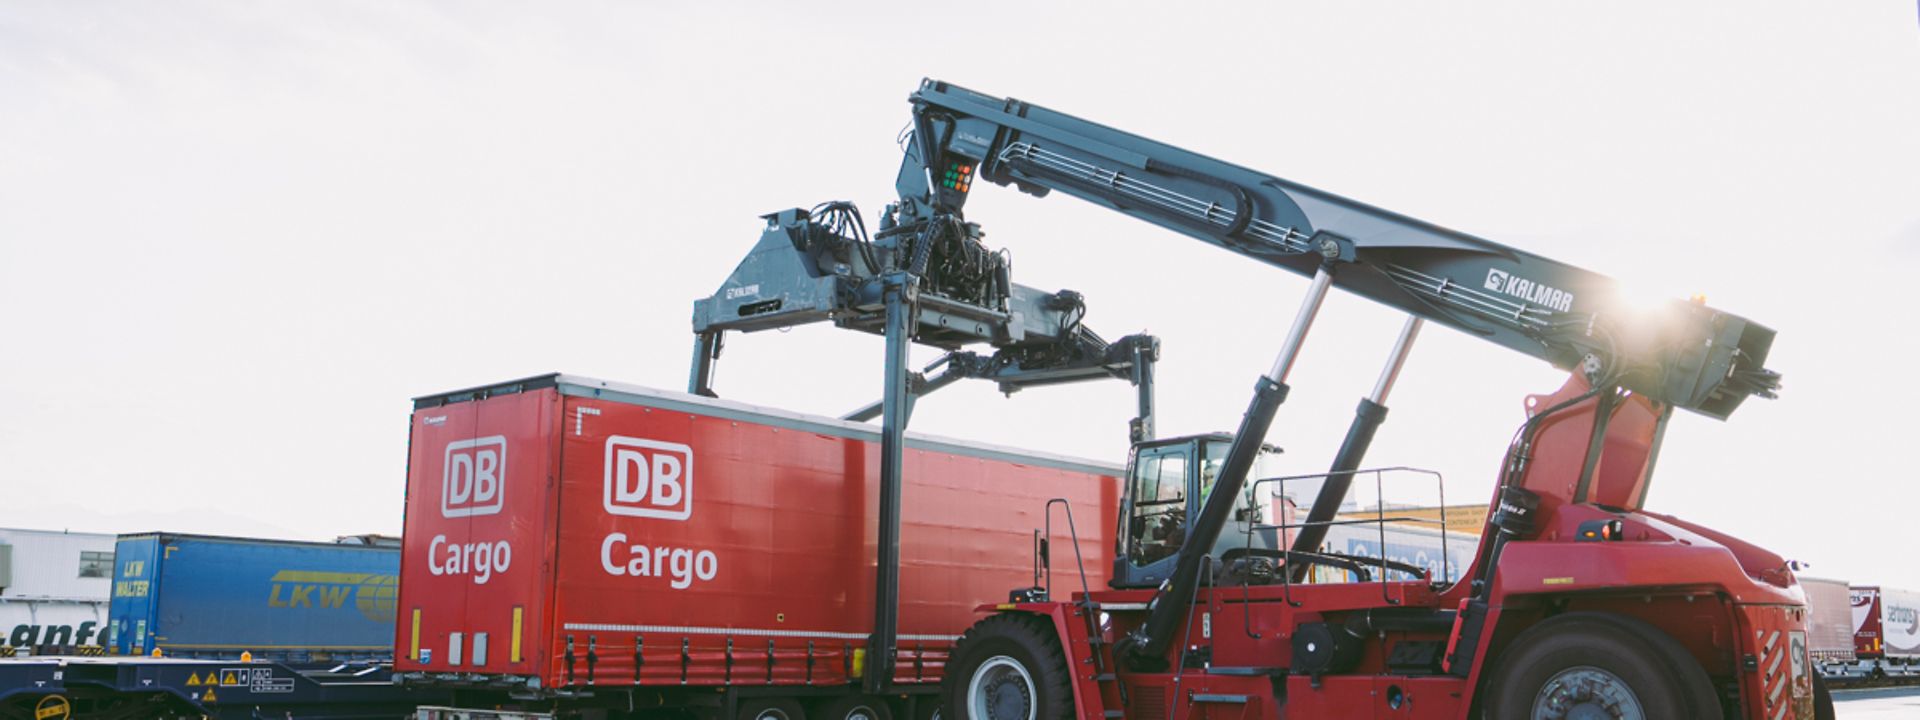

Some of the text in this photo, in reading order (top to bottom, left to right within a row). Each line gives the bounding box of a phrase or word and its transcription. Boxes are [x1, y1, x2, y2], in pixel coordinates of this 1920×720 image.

[1505, 275, 1573, 313] KALMAR
[450, 450, 498, 504] DB
[616, 449, 682, 506] DB
[428, 534, 511, 584] Cargo
[600, 532, 718, 590] Cargo
[116, 581, 149, 597] WALTER
[268, 584, 352, 608] LKW
